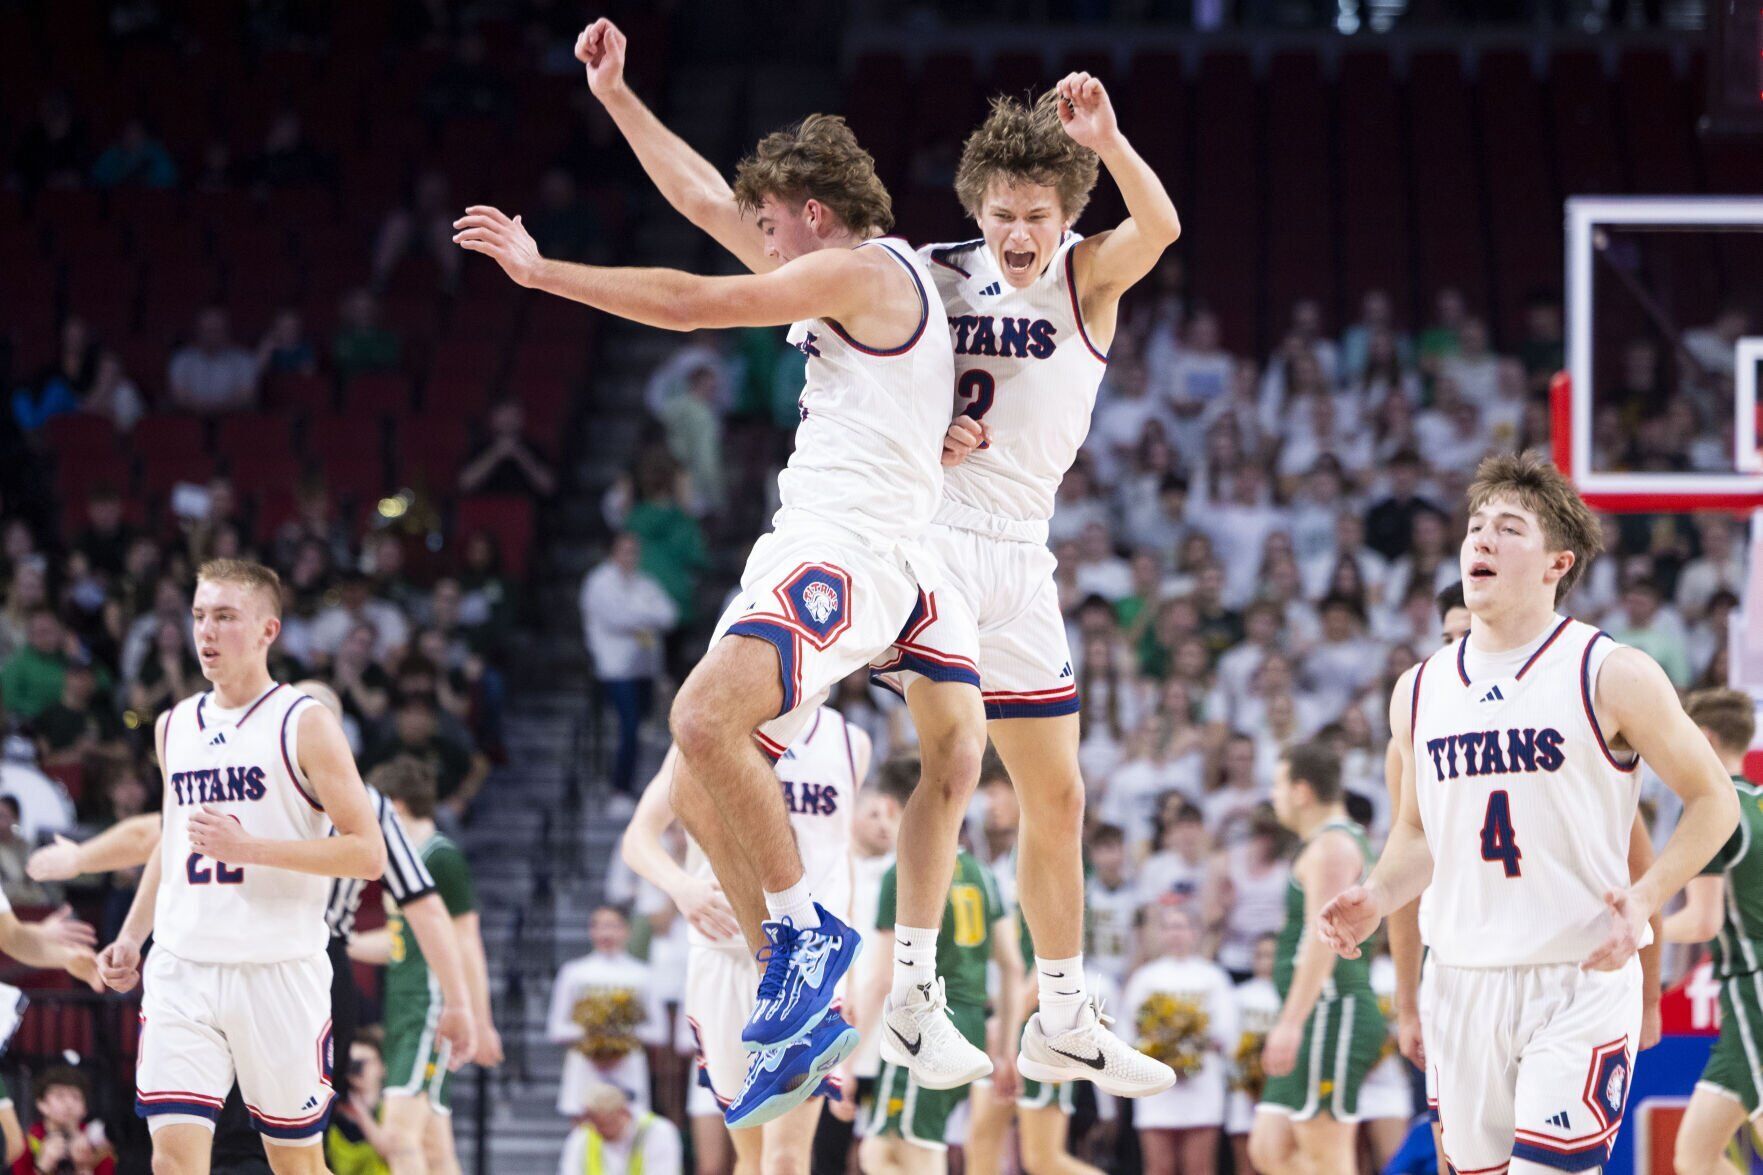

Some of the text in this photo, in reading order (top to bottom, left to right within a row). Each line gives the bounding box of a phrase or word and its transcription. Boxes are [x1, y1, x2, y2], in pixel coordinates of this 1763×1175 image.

[947, 315, 1057, 360] TANS
[958, 368, 995, 450] 2
[1426, 728, 1565, 782] TITANS
[171, 766, 267, 806] TITANS
[1480, 789, 1522, 878] 4
